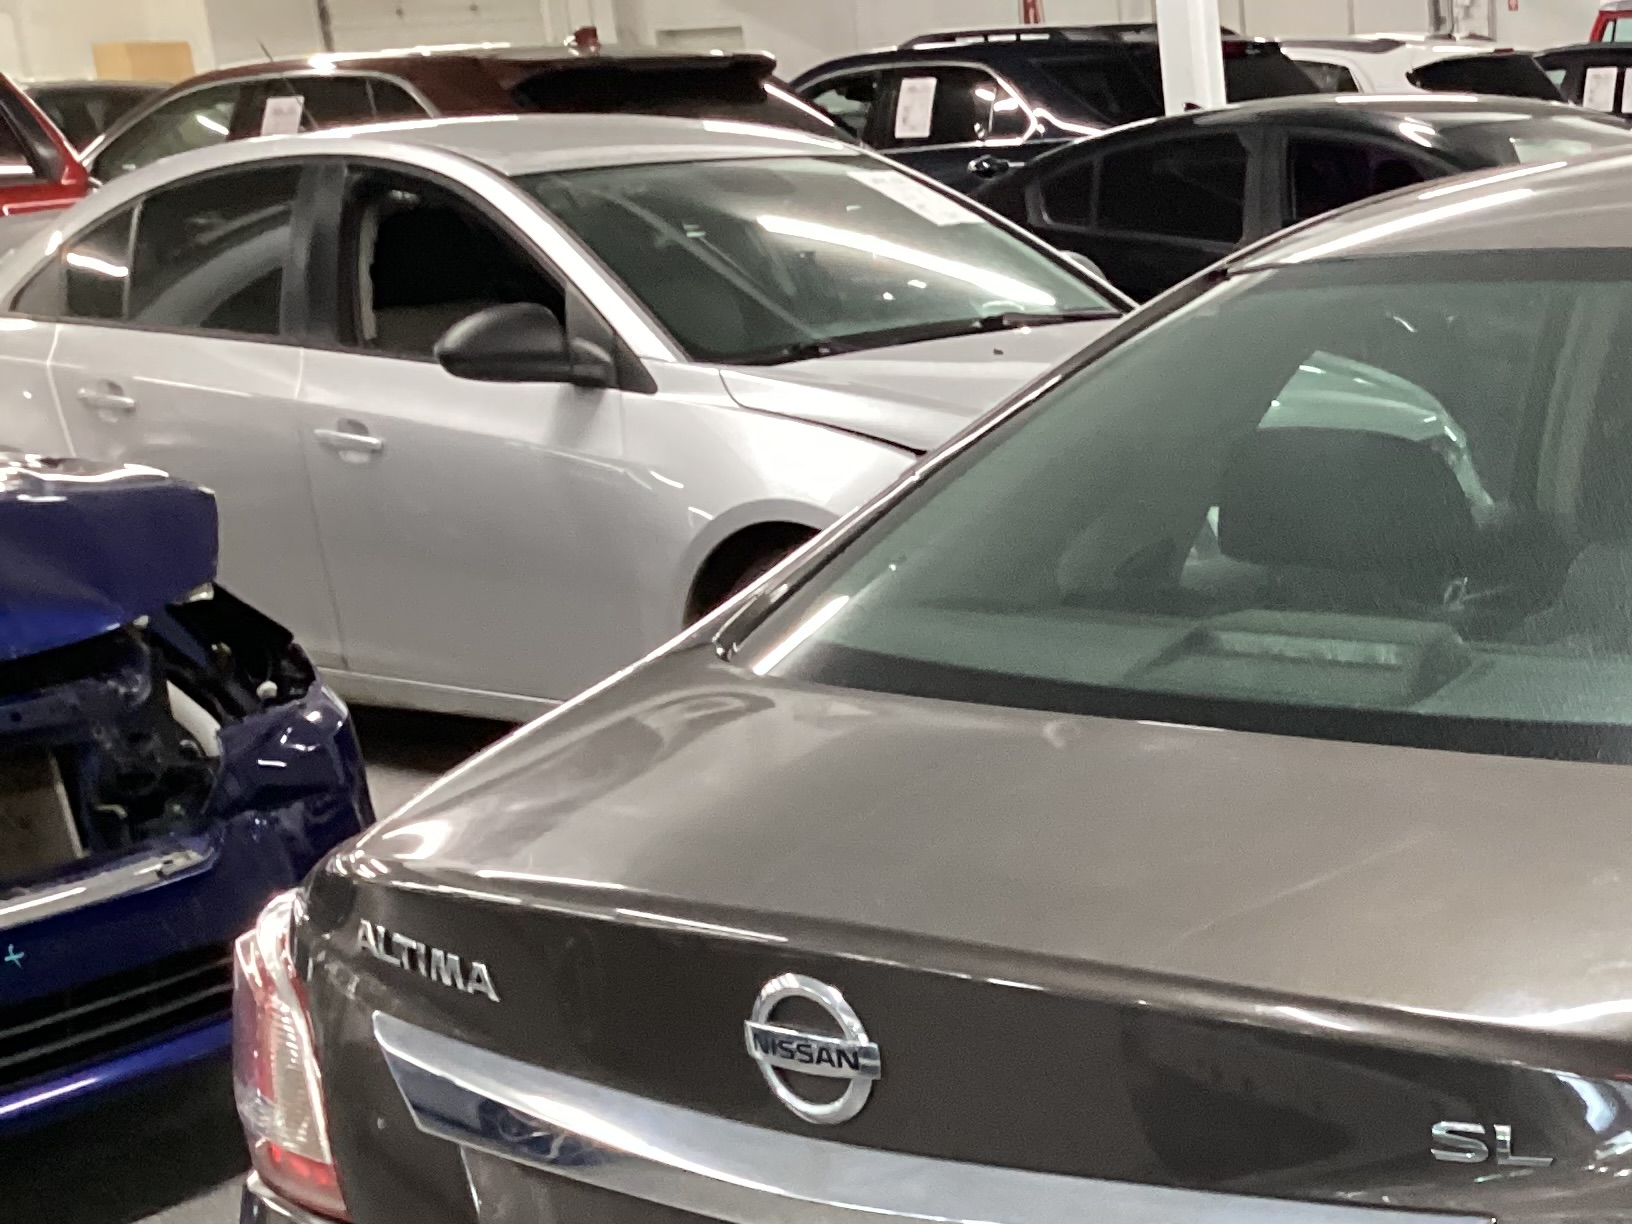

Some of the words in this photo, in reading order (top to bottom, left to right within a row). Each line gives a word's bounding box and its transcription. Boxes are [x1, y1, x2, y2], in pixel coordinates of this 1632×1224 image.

[355, 918, 500, 1002] ALTIMA
[753, 1032, 860, 1071] NISSAN
[1430, 1120, 1554, 1167] SL
